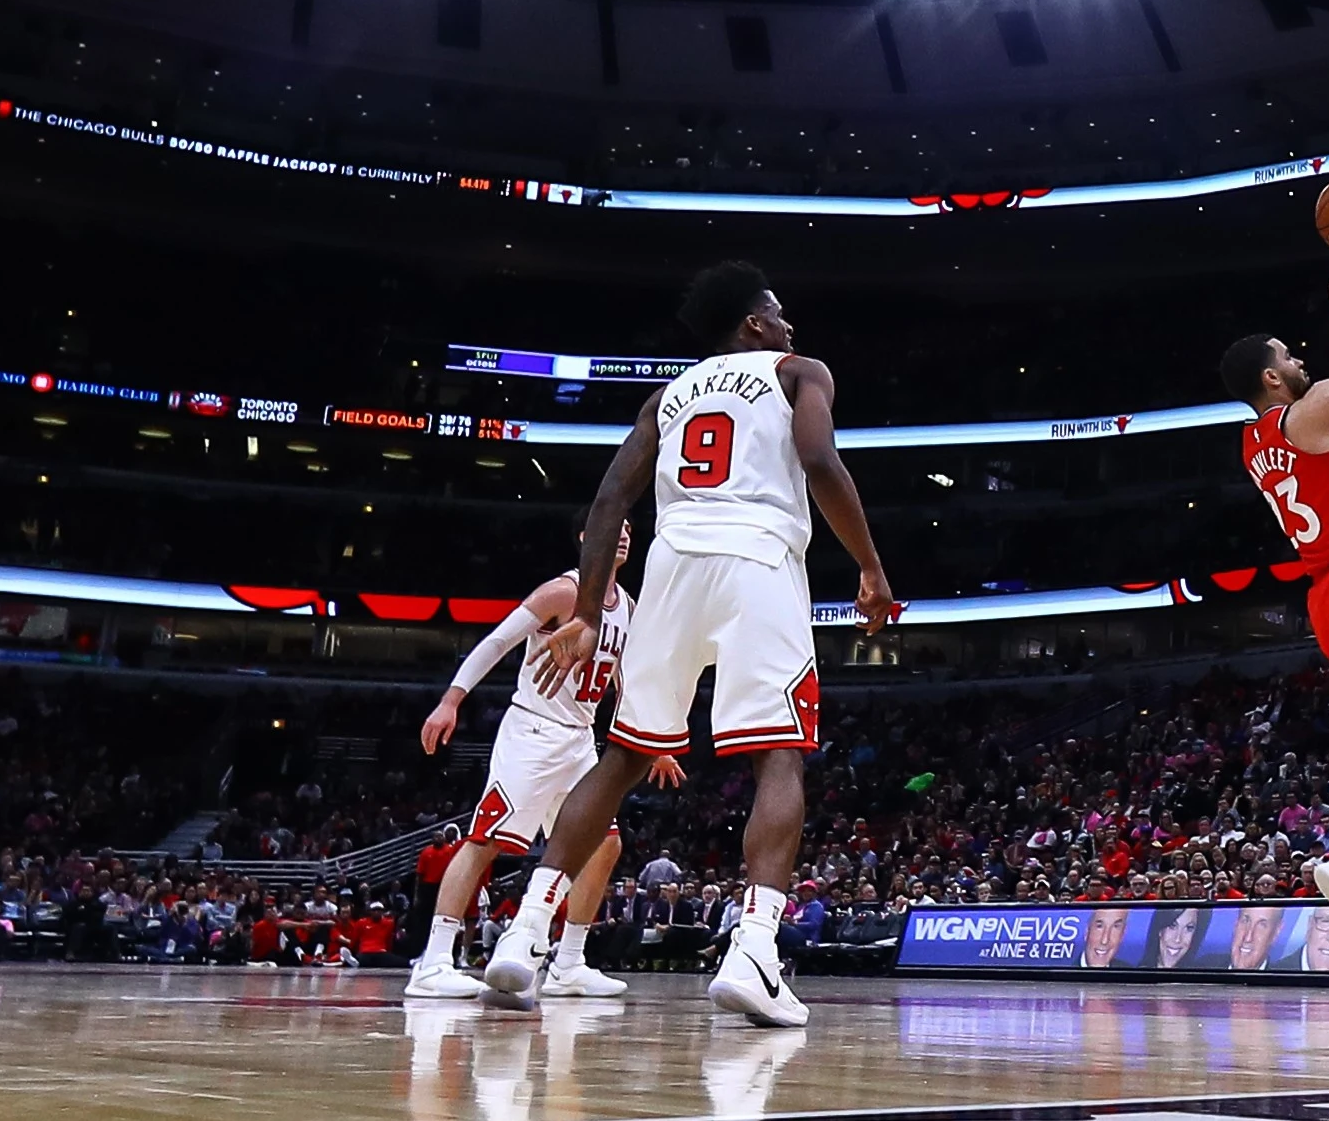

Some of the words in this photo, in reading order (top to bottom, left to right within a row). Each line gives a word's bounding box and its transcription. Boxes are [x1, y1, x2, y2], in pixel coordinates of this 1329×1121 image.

[14, 106, 42, 123] THE
[46, 113, 117, 137] CHICAGO
[121, 127, 165, 146] BULLS
[217, 145, 270, 166] RAFFLE
[272, 156, 338, 175] JACKPOT
[341, 165, 354, 177] IS
[357, 166, 433, 185] CURRENTLY
[1254, 167, 1275, 183] RUN
[634, 363, 653, 376] TO
[56, 379, 116, 397] HARRIS
[119, 387, 160, 403] CLUB
[661, 370, 774, 421] BLAKENEY
[239, 397, 299, 413] TORONTO
[237, 408, 296, 424] CHICAGO
[332, 409, 374, 426] FIELD
[377, 414, 426, 430] GOALS
[1050, 422, 1076, 440] RUN
[1076, 420, 1100, 435] WITH
[1101, 418, 1114, 433] US
[676, 410, 736, 490] 9
[978, 948, 991, 958] AT
[990, 942, 1028, 959] NINE
[1029, 943, 1041, 959] &
[1043, 942, 1075, 959] TEN
